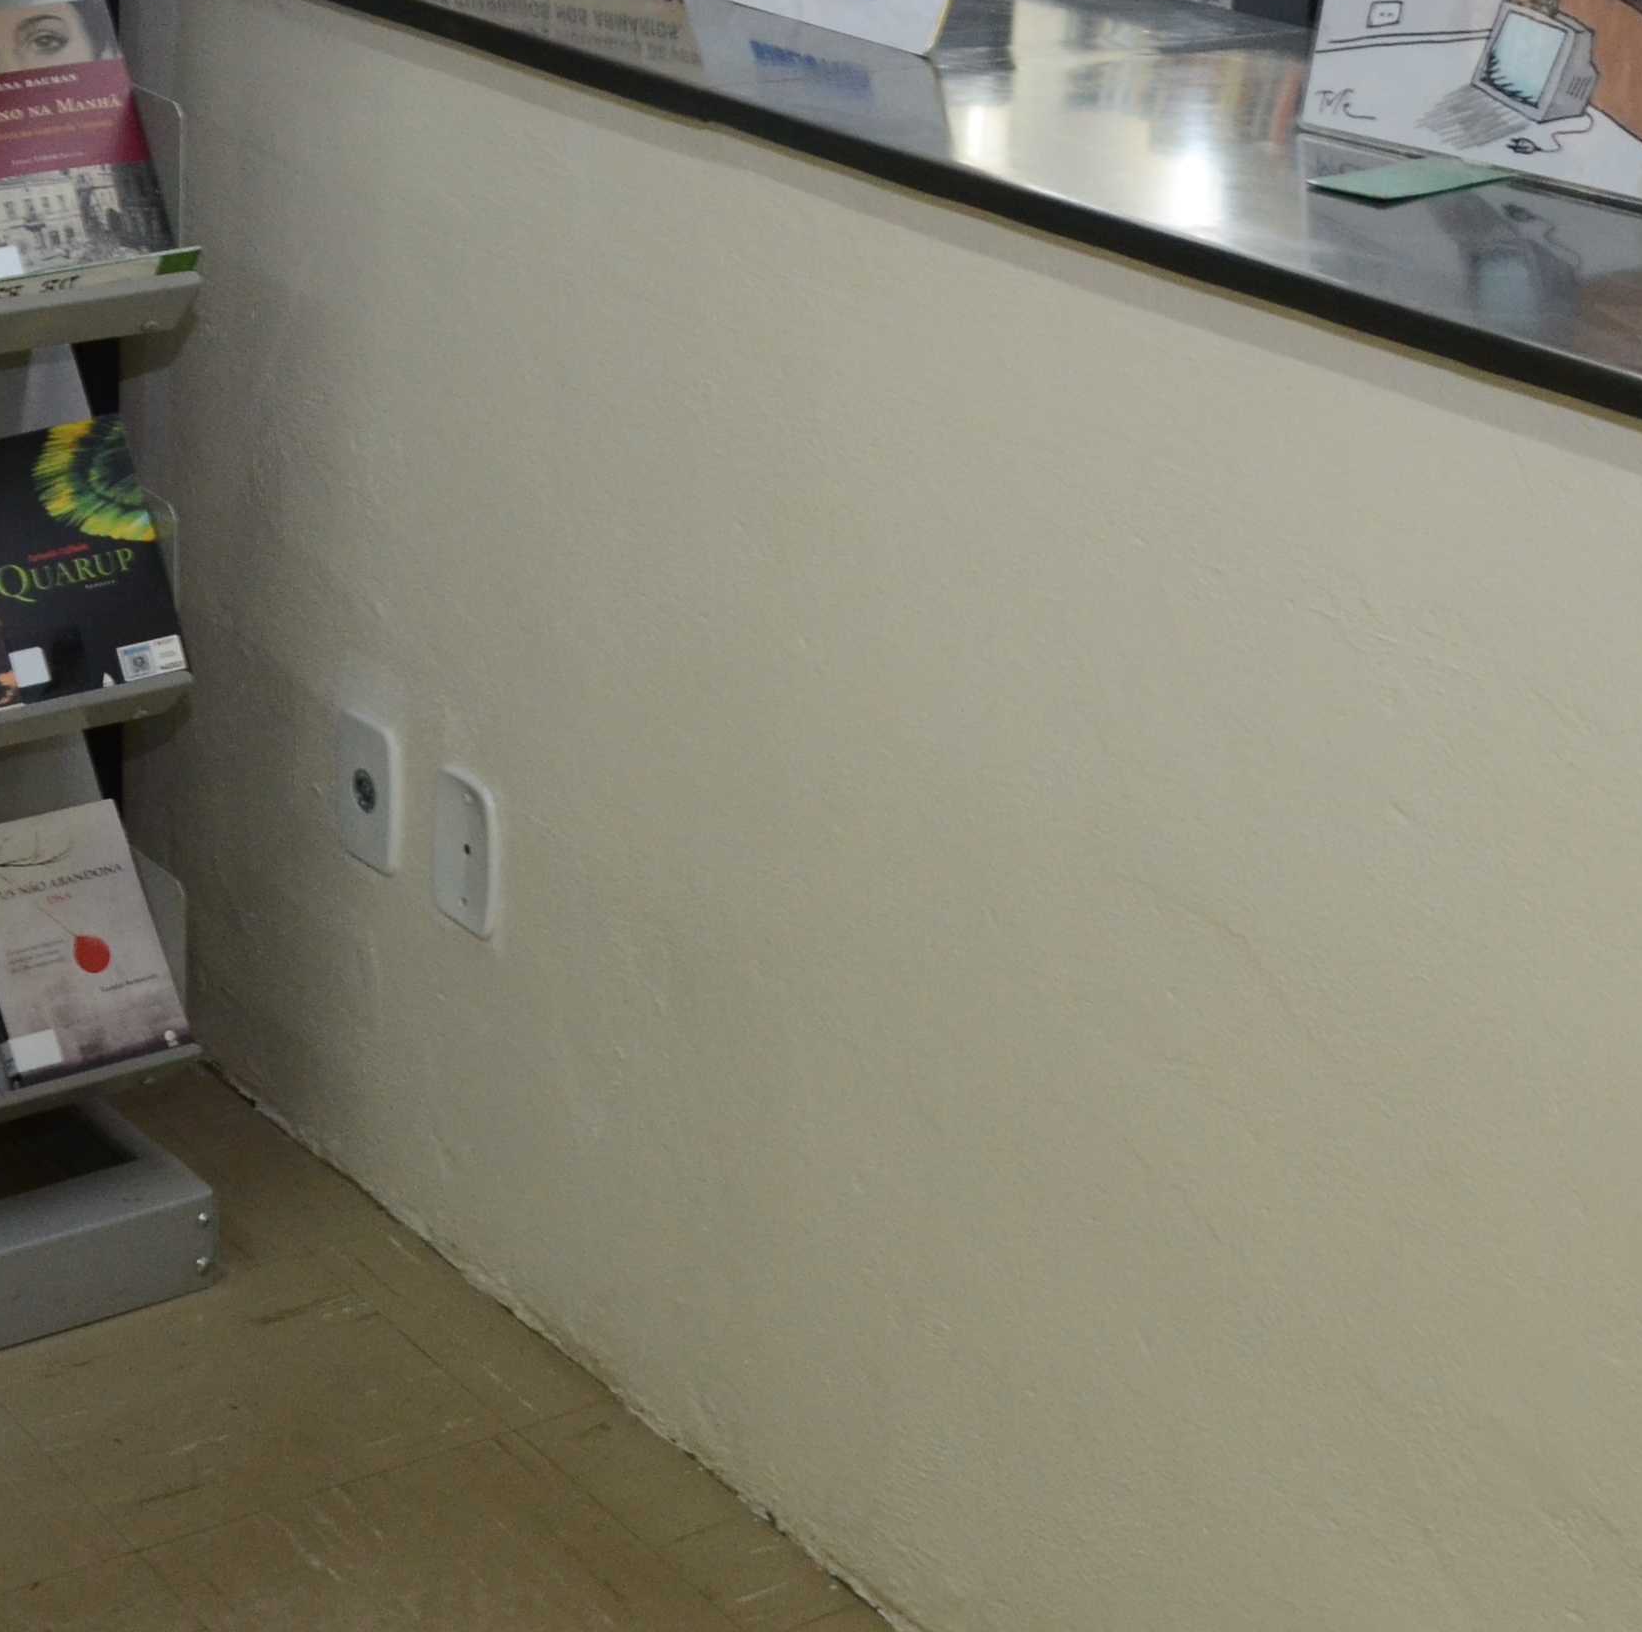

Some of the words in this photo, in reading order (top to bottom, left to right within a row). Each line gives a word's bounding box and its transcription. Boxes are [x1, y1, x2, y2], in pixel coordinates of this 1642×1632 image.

[25, 72, 79, 88] BAUMAN
[18, 879, 46, 899] NÃO
[45, 863, 123, 891] ABANDONA
